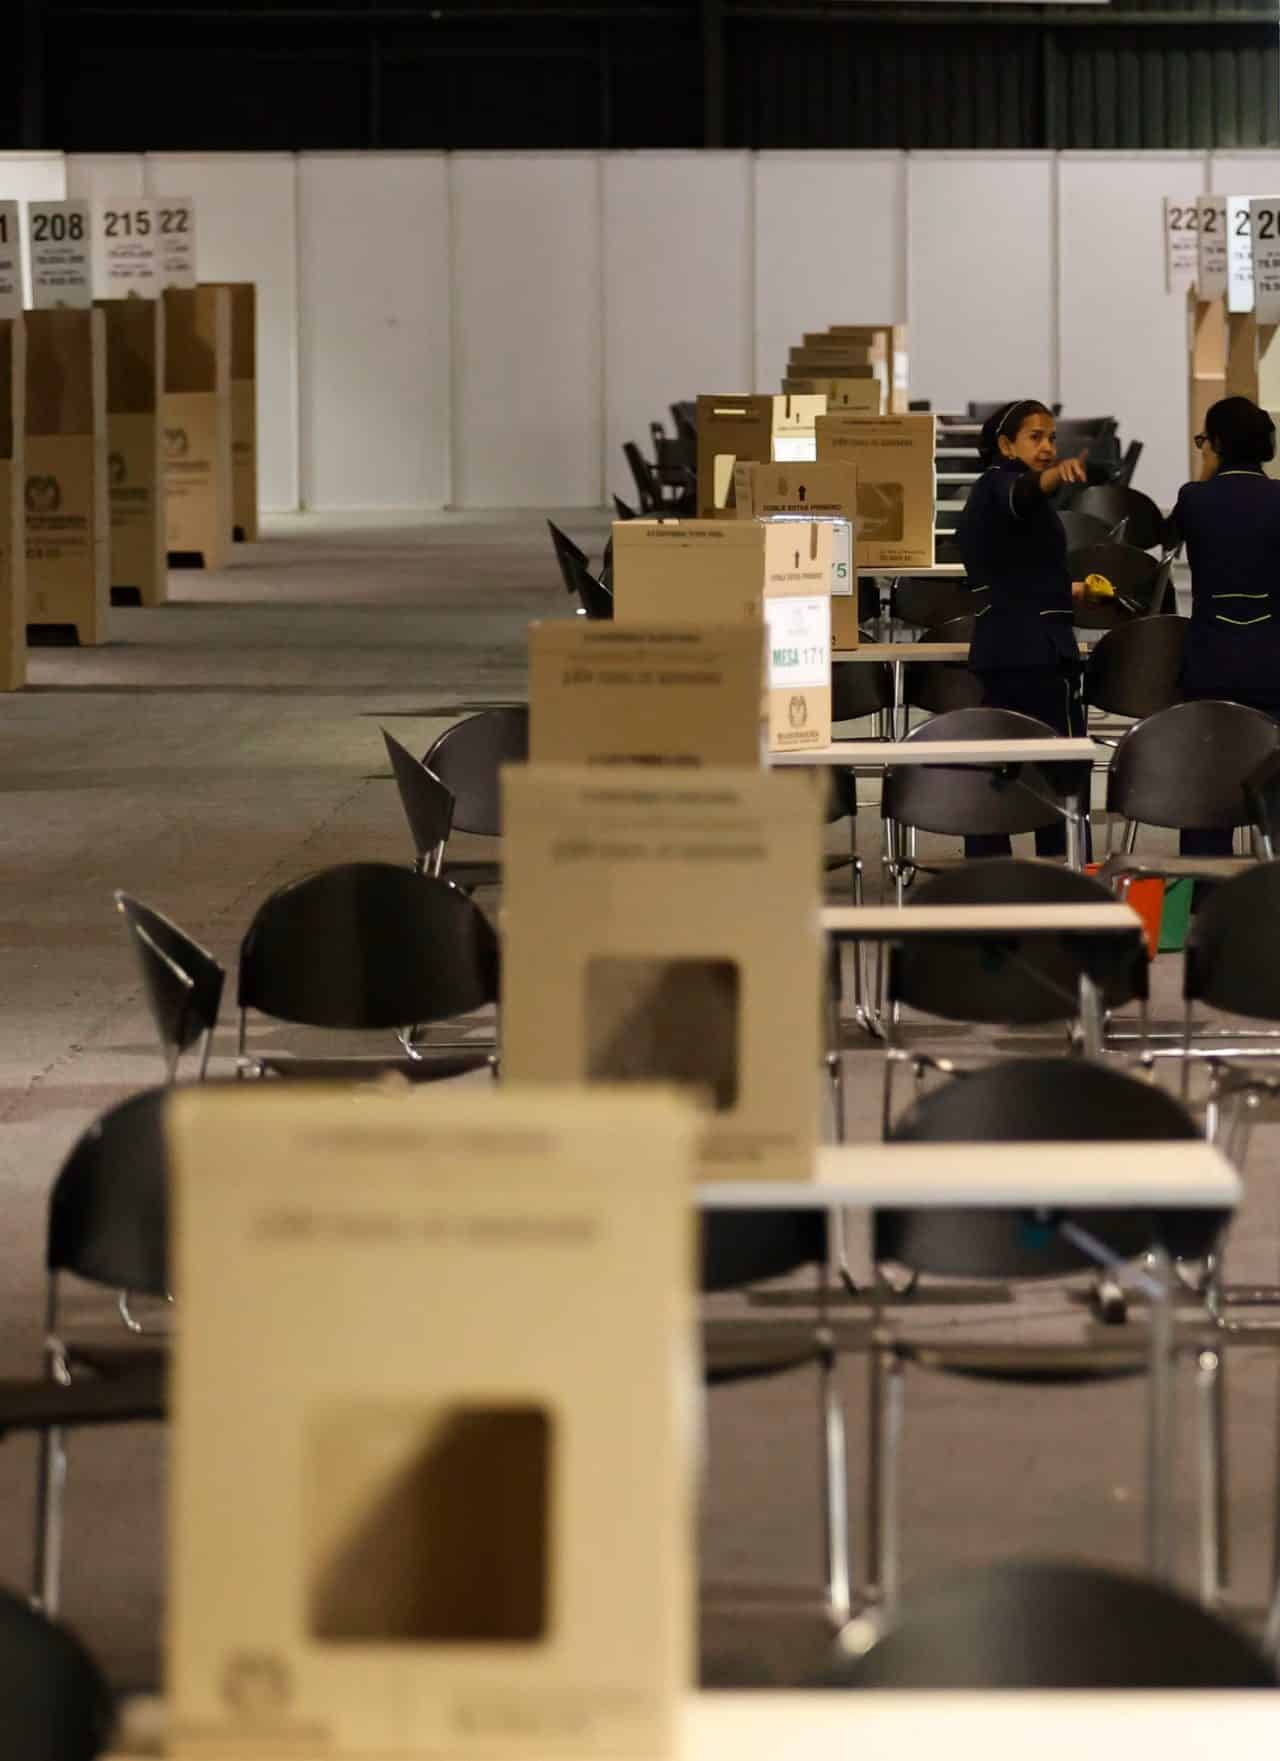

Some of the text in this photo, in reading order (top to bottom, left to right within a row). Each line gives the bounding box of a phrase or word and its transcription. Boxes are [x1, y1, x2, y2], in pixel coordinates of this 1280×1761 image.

[33, 213, 84, 241] 208
[104, 210, 151, 237] 215
[160, 209, 188, 234] 22
[832, 562, 847, 578] 5
[773, 648, 799, 666] MESA
